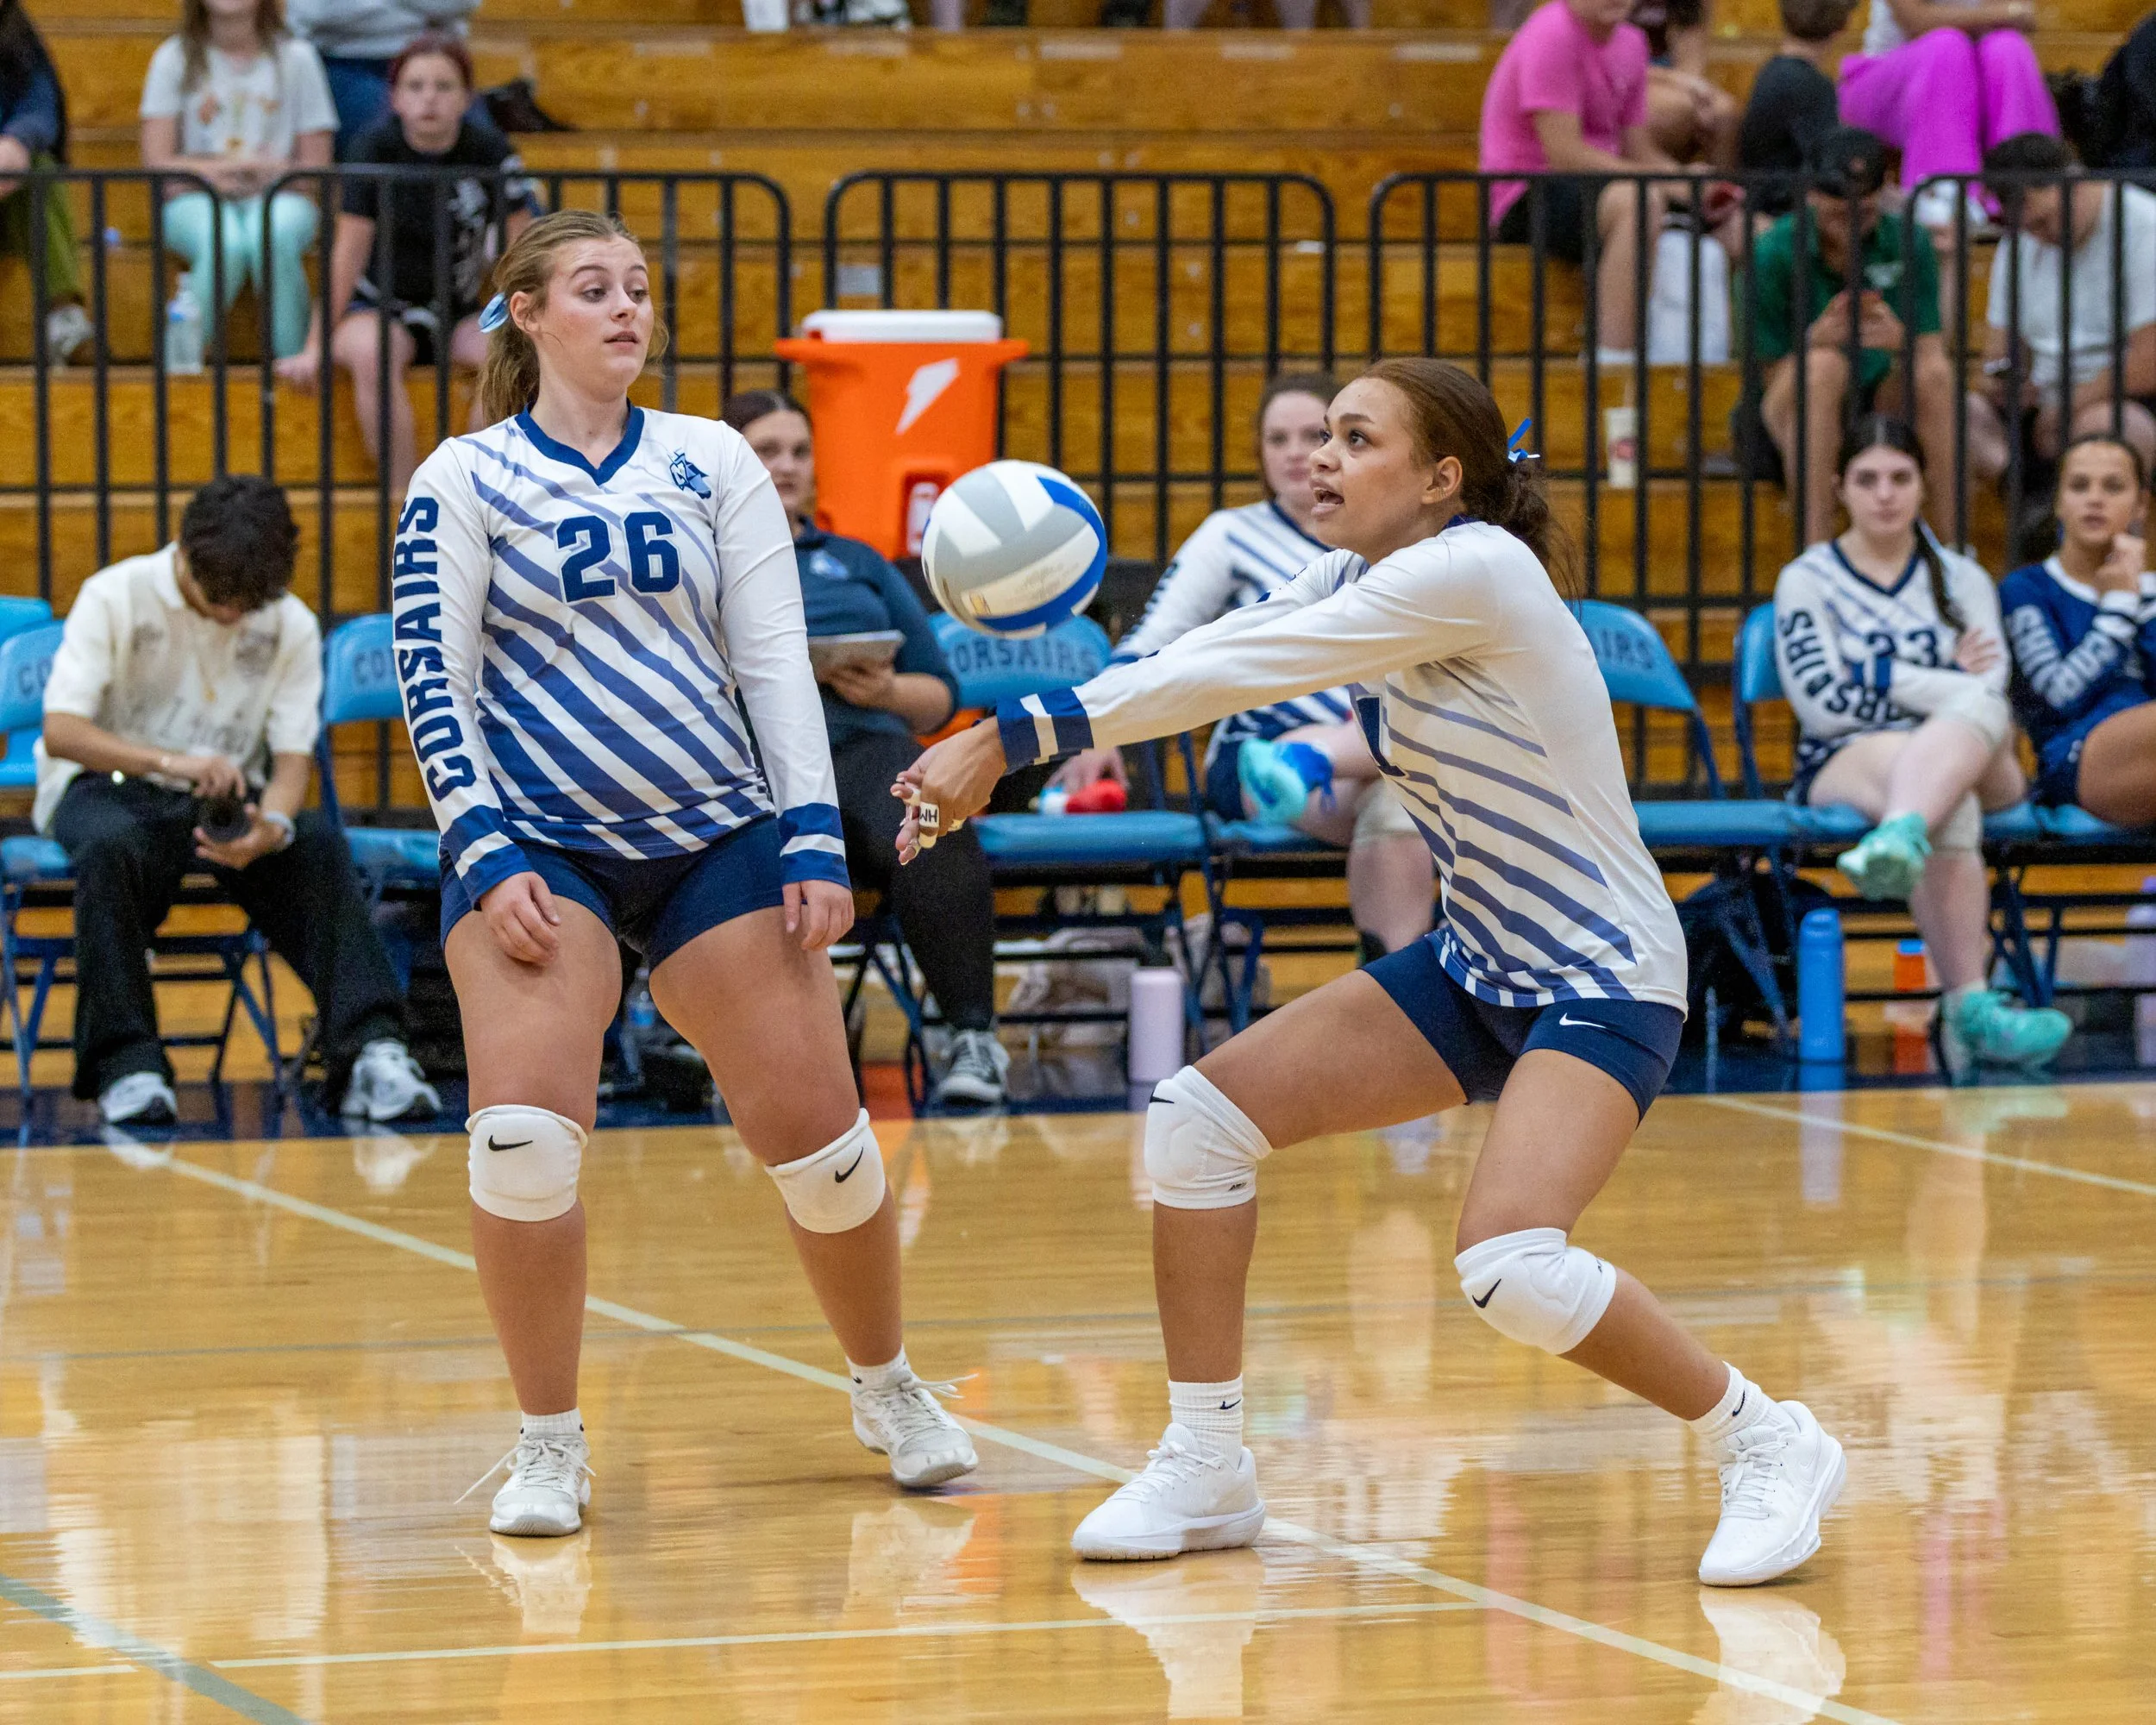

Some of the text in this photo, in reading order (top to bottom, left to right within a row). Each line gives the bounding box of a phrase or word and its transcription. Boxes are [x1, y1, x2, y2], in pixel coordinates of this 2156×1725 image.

[555, 511, 682, 604] 26
[394, 497, 476, 802] CORSAIRS
[954, 637, 1097, 679] ORSAIRS
